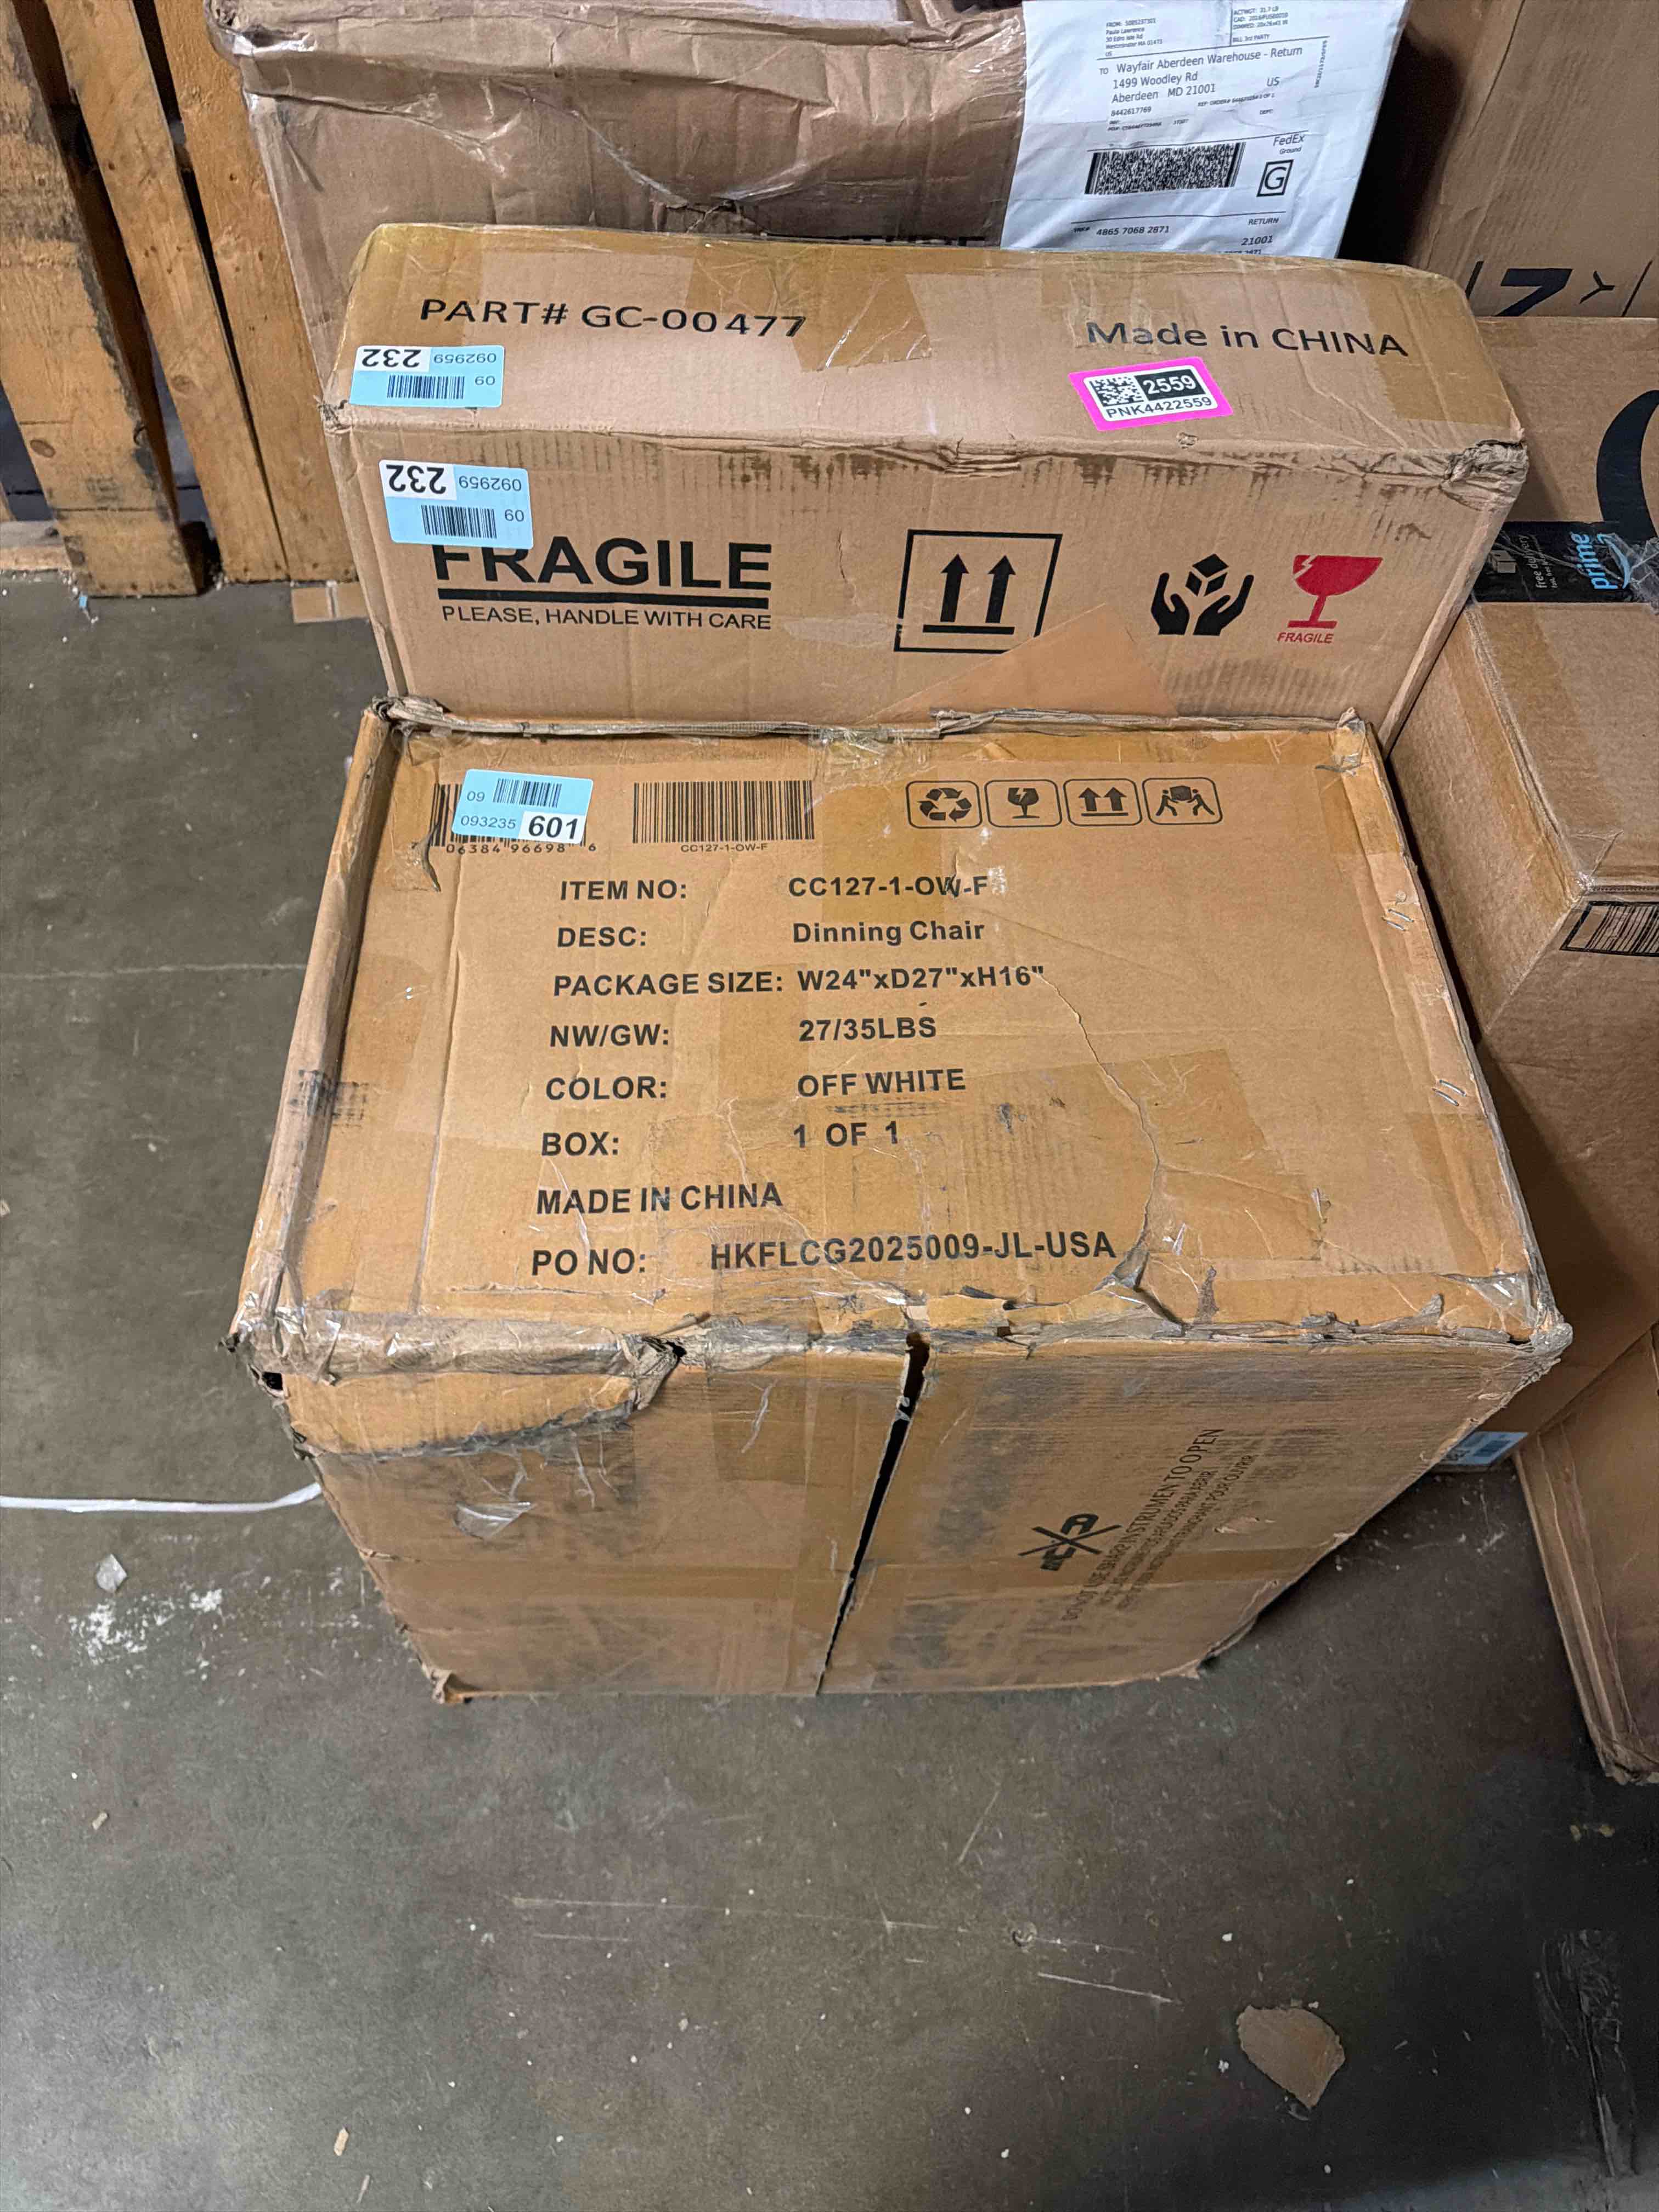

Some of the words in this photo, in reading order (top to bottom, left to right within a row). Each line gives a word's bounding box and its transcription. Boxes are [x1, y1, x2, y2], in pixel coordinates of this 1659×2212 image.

[1116, 61, 1154, 74] Wayfair
[1156, 57, 1204, 69] Aberdeen
[1207, 52, 1261, 64] Warehouse
[1270, 47, 1303, 58] Return
[1113, 77, 1137, 89] 1499
[1141, 74, 1182, 86] Woodley
[1185, 71, 1198, 82] Rd
[1266, 77, 1280, 87] US
[1111, 91, 1159, 104] Aberdeen
[1167, 87, 1183, 97] MD
[1186, 83, 1216, 95] 21001
[1273, 134, 1305, 146] FedEx
[1264, 166, 1287, 190] G
[1096, 228, 1119, 236] 4865
[1122, 227, 1145, 235] 7068
[1147, 225, 1170, 234] 2871
[1240, 235, 1273, 246] 21001
[420, 298, 568, 325] PART#
[582, 306, 807, 337] GC-00477
[1087, 321, 1207, 347] Made
[1221, 324, 1259, 349] in
[1272, 328, 1409, 357] CHINA
[362, 348, 422, 368] 232
[433, 353, 497, 364] 092959
[474, 375, 496, 386] 09
[1143, 375, 1197, 394] 2559
[1105, 397, 1212, 418] PNK4422559
[386, 465, 447, 494] 232
[459, 475, 522, 492] 092959
[504, 509, 524, 522] 09
[432, 536, 772, 591] FRAGILE
[1571, 532, 1618, 590] prime
[1533, 571, 1548, 589] free
[442, 605, 540, 626] PLEASE,
[546, 609, 639, 626] HANDLE
[645, 611, 703, 628] WITH
[709, 612, 772, 630] CARE
[1277, 631, 1334, 644] FRAGILE
[466, 791, 486, 802] 09
[460, 815, 517, 830] 093235
[528, 815, 579, 839] 601
[680, 842, 769, 853] CC127-1-OW-F
[560, 880, 629, 900] ITEM
[636, 879, 687, 899] NO:
[788, 875, 989, 899] CC127-1-OW-F
[557, 926, 647, 947] DESC:
[792, 921, 902, 946] Dinning
[910, 920, 985, 941] Chair
[554, 973, 699, 997] PACKAGE
[707, 970, 784, 994] SIZE:
[798, 966, 1045, 991] W24"xD27"xH16"
[549, 1024, 670, 1047] NW/GW:
[798, 1016, 937, 1042] 27/35LBS
[546, 1075, 667, 1101] COLOR:
[797, 1074, 857, 1098] OFF
[865, 1068, 967, 1094] WHITE
[541, 1130, 619, 1157] BOX:
[793, 1124, 806, 1148] 1
[826, 1122, 867, 1147] OF
[885, 1120, 899, 1144] 1
[536, 1188, 631, 1215] MADE
[640, 1186, 671, 1212] IN
[680, 1181, 784, 1210] CHINA
[531, 1249, 578, 1277] PO
[587, 1247, 646, 1274] NO:
[711, 1231, 1116, 1269] HKFLCG2025009-JL-USA
[1163, 1465, 1193, 1482] TO
[1179, 1428, 1225, 1463] OPEN
